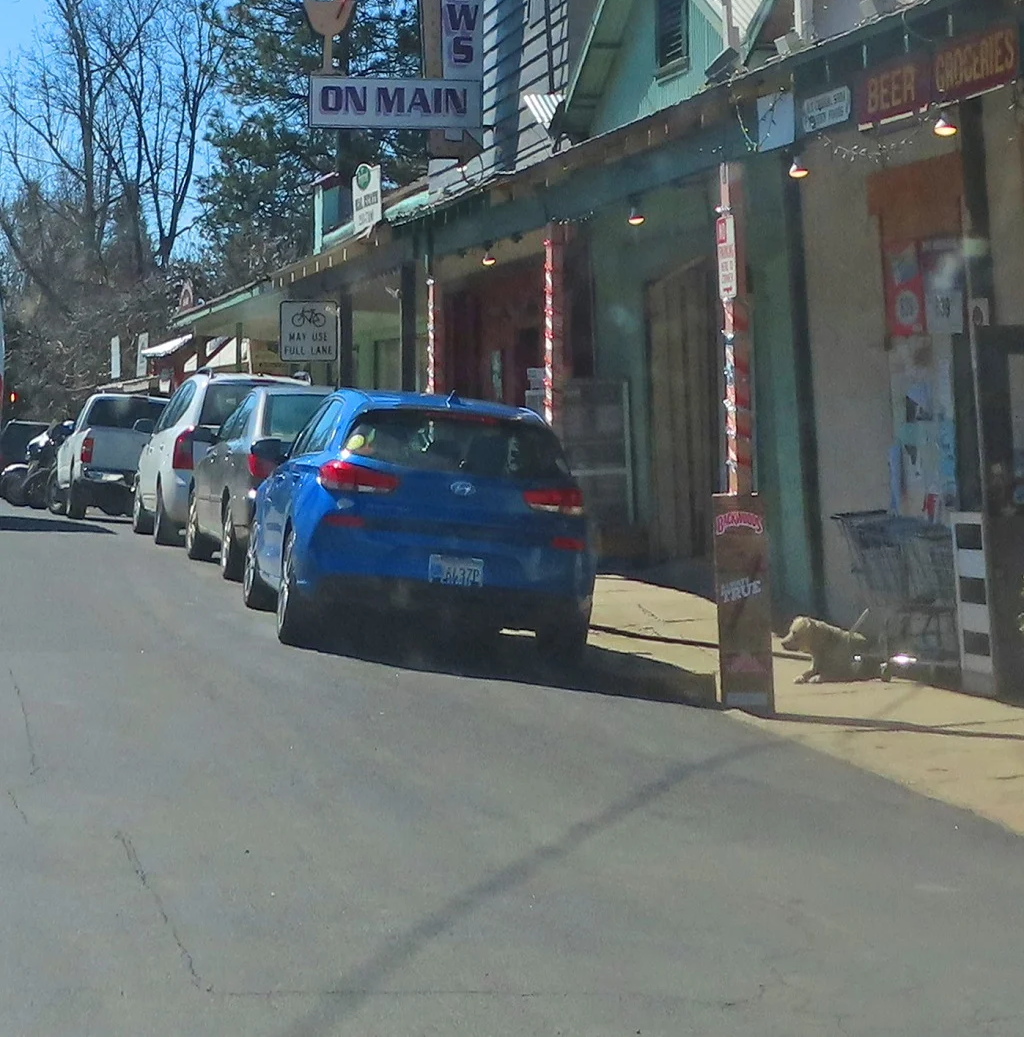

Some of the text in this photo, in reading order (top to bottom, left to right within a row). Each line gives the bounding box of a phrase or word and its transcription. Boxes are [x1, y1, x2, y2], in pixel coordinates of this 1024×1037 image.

[867, 65, 916, 113] BEER
[934, 29, 1016, 92] GROCERIES
[320, 85, 468, 115] ON MAIN
[288, 332, 328, 343] MAY USE
[284, 346, 333, 356] FULL LANE
[720, 580, 762, 603] TRUE
